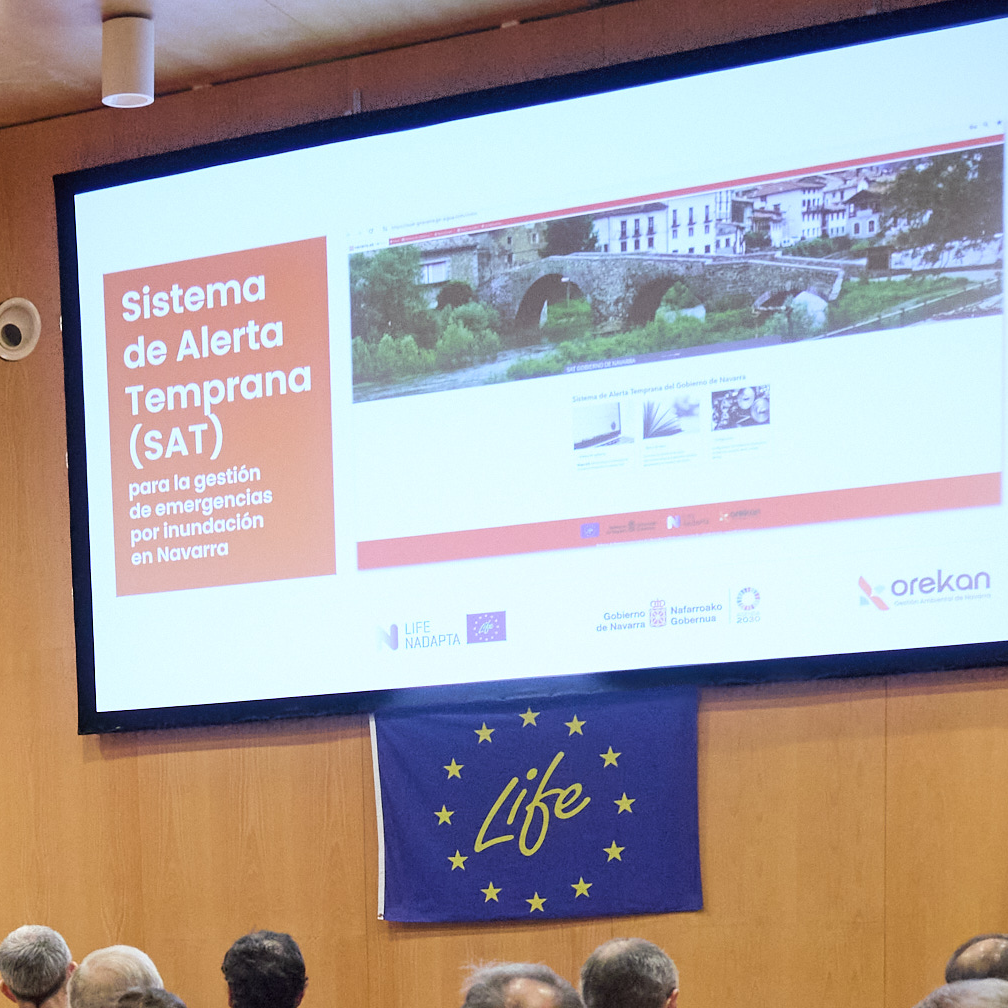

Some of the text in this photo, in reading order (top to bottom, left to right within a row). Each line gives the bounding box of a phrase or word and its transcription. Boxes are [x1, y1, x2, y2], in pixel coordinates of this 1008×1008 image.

[122, 275, 266, 322] Sistema
[123, 321, 283, 369] de Alerta
[125, 365, 312, 416] Temprana
[572, 395, 597, 403] Sistema
[609, 389, 629, 398] Alerta
[631, 386, 663, 396] Temprana
[676, 379, 708, 389] Gobierno
[719, 375, 746, 383] Navarra
[129, 413, 224, 469] (SAT)
[128, 464, 262, 499] para la gestión
[129, 487, 273, 519] de emergencias
[130, 512, 264, 547] por inundación
[131, 539, 229, 565] en Navarra
[891, 569, 991, 597] orekan
[603, 610, 646, 621] Gobierno
[670, 602, 723, 615] Nafarroako
[670, 614, 717, 625] Gobernua
[736, 616, 761, 624] 2030
[405, 620, 431, 635] LIFE
[596, 621, 646, 632] de Navarra
[405, 633, 461, 650] NADAPTA
[474, 751, 591, 856] Life
